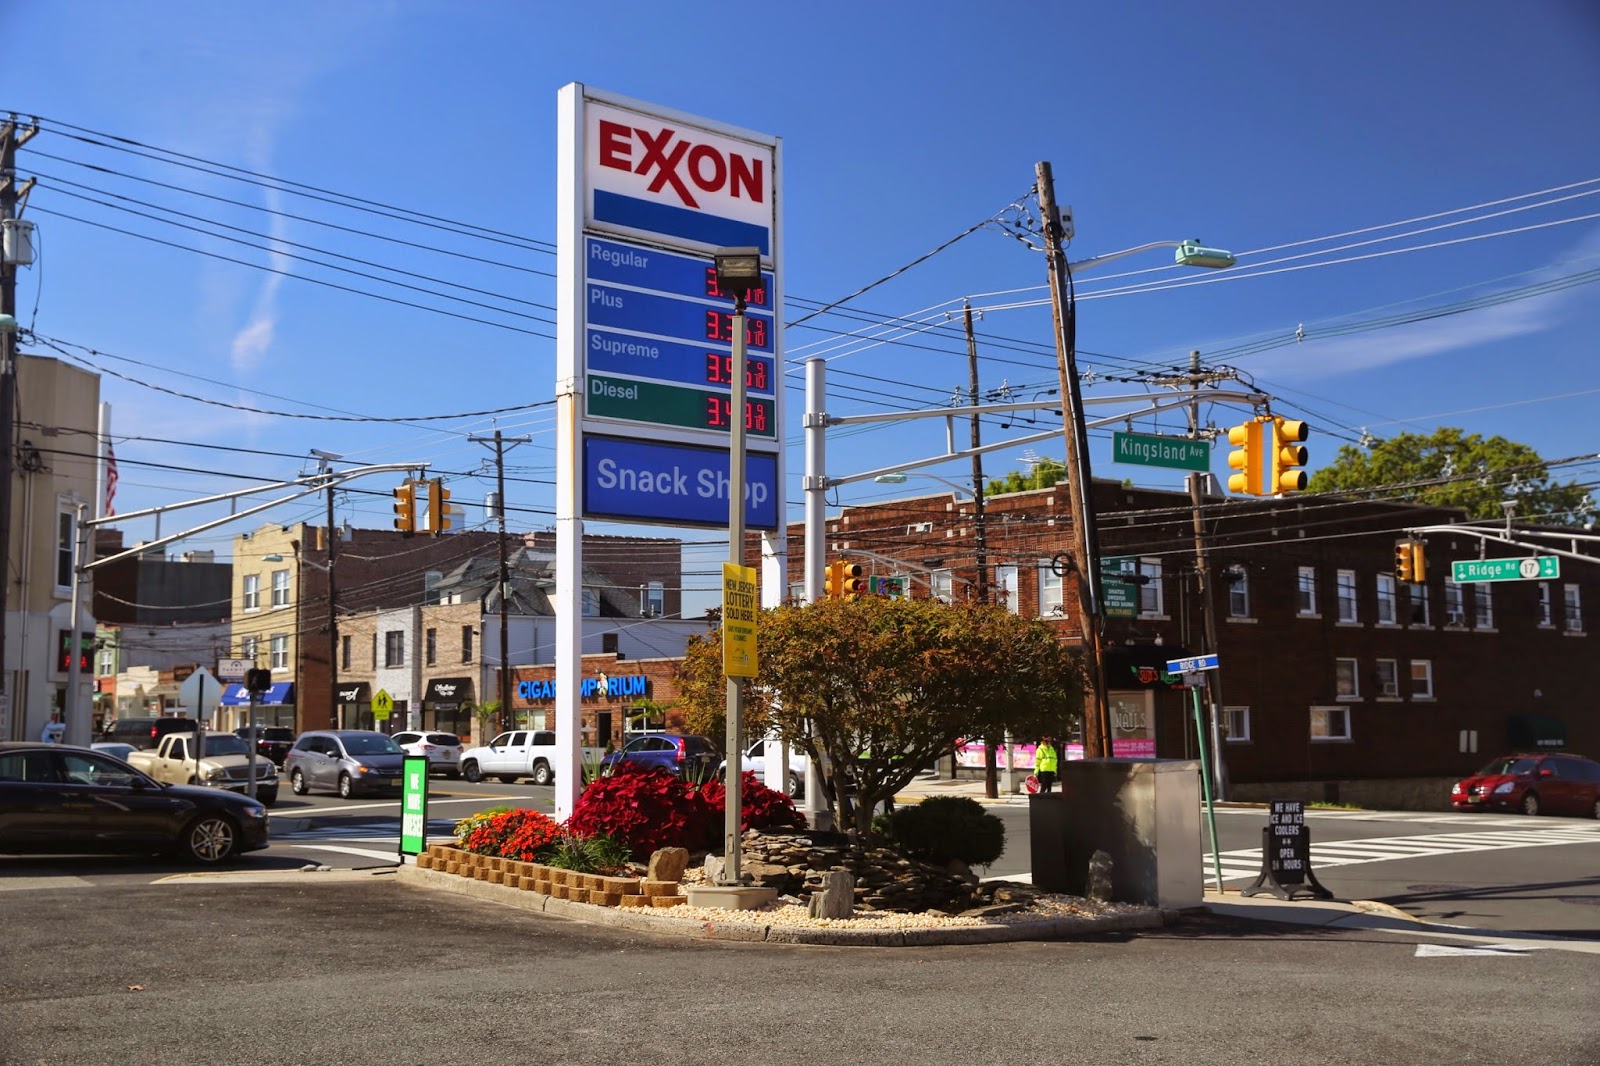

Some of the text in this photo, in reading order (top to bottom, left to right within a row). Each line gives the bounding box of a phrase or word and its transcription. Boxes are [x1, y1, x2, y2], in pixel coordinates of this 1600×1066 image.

[599, 119, 763, 209] EXXON
[591, 243, 649, 268] Regular
[591, 288, 624, 309] Plus
[591, 334, 659, 359] Supreme
[591, 379, 638, 400] Diesel
[1120, 437, 1204, 462] Kingsland Ave
[597, 458, 689, 496] Snack
[1468, 562, 1516, 578] Ridge Rd
[1524, 563, 1535, 574] 17
[725, 578, 755, 595] NEW JERSEY
[725, 591, 754, 610] LOTTERY
[725, 607, 740, 620] SOLD
[1179, 658, 1207, 671] RIDGE RD
[517, 679, 557, 699] CIGA
[1274, 802, 1300, 812] WE HAVE
[1281, 814, 1293, 824] AND
[1293, 813, 1303, 824] ICE
[1274, 825, 1300, 836] COOLERS
[1279, 848, 1294, 858] OPEN
[1283, 859, 1302, 870] HOURS
